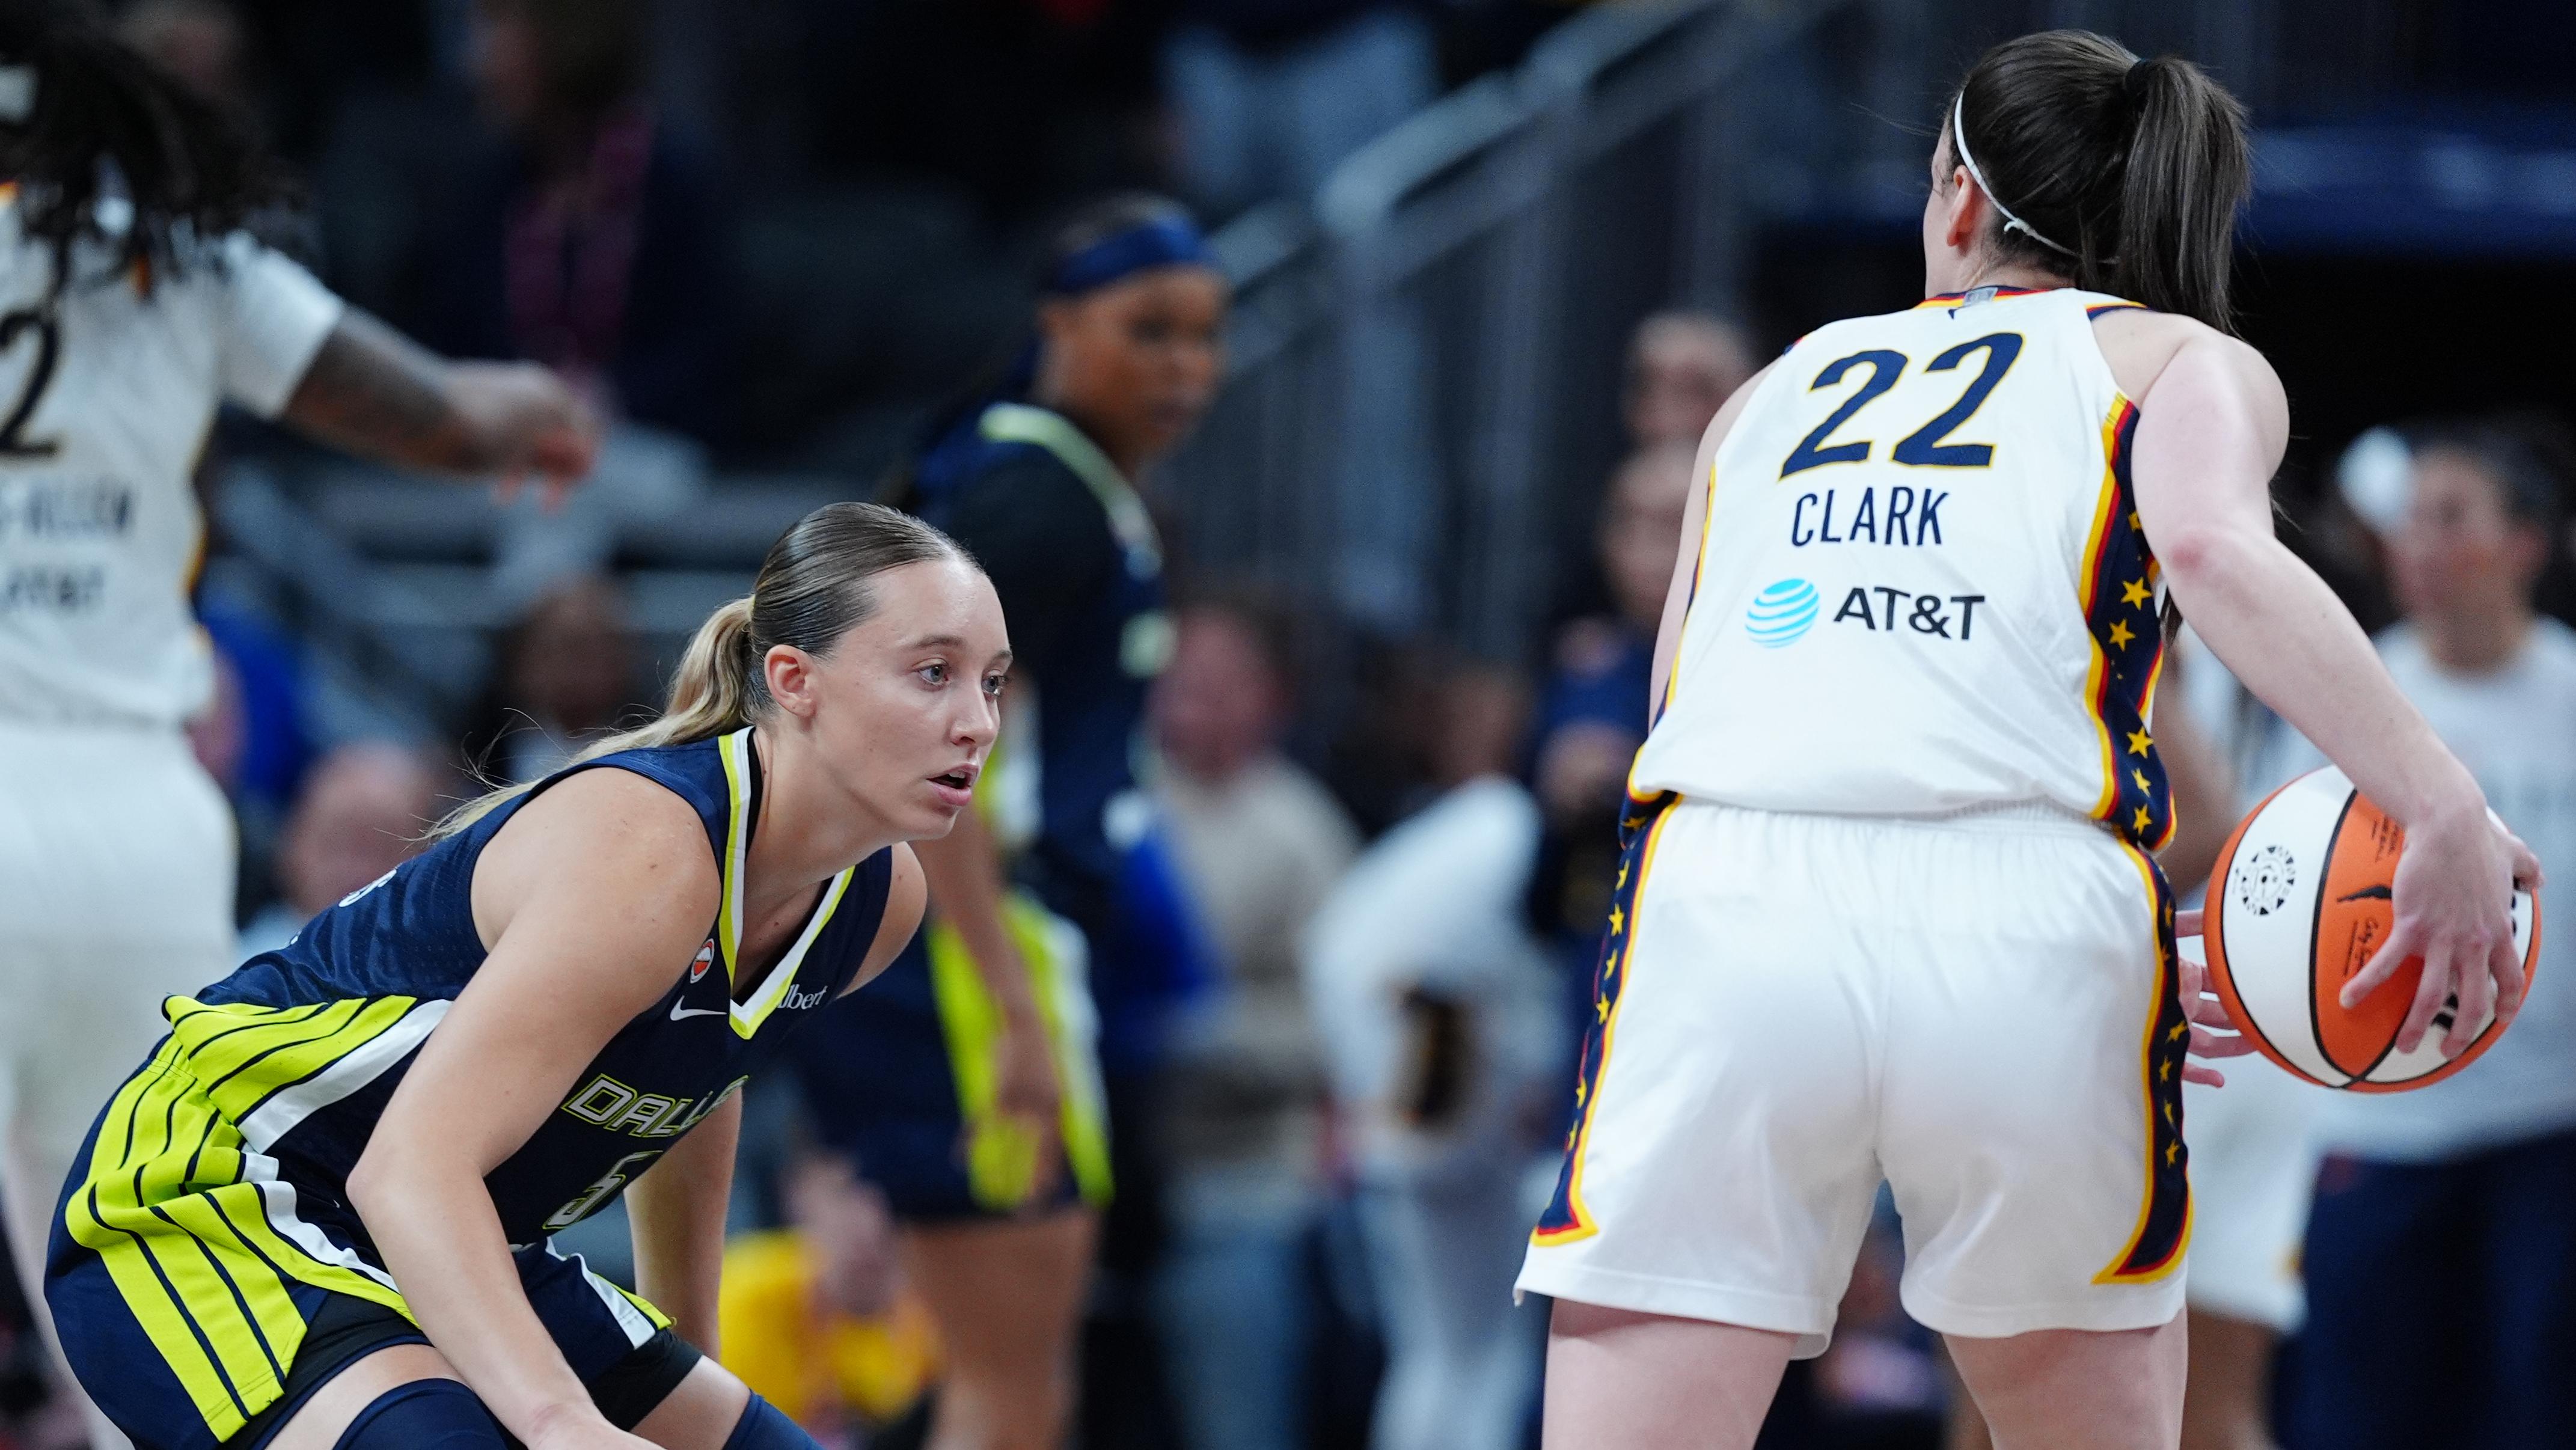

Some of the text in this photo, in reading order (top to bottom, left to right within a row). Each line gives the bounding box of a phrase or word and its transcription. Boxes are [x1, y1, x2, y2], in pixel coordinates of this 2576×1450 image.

[1777, 331, 2026, 483] 22
[1791, 486, 1950, 546] CLARK
[1834, 587, 1986, 641] AT&T
[777, 983, 828, 1010] lbert
[561, 1073, 750, 1137] DALL
[542, 1150, 663, 1230] 5
